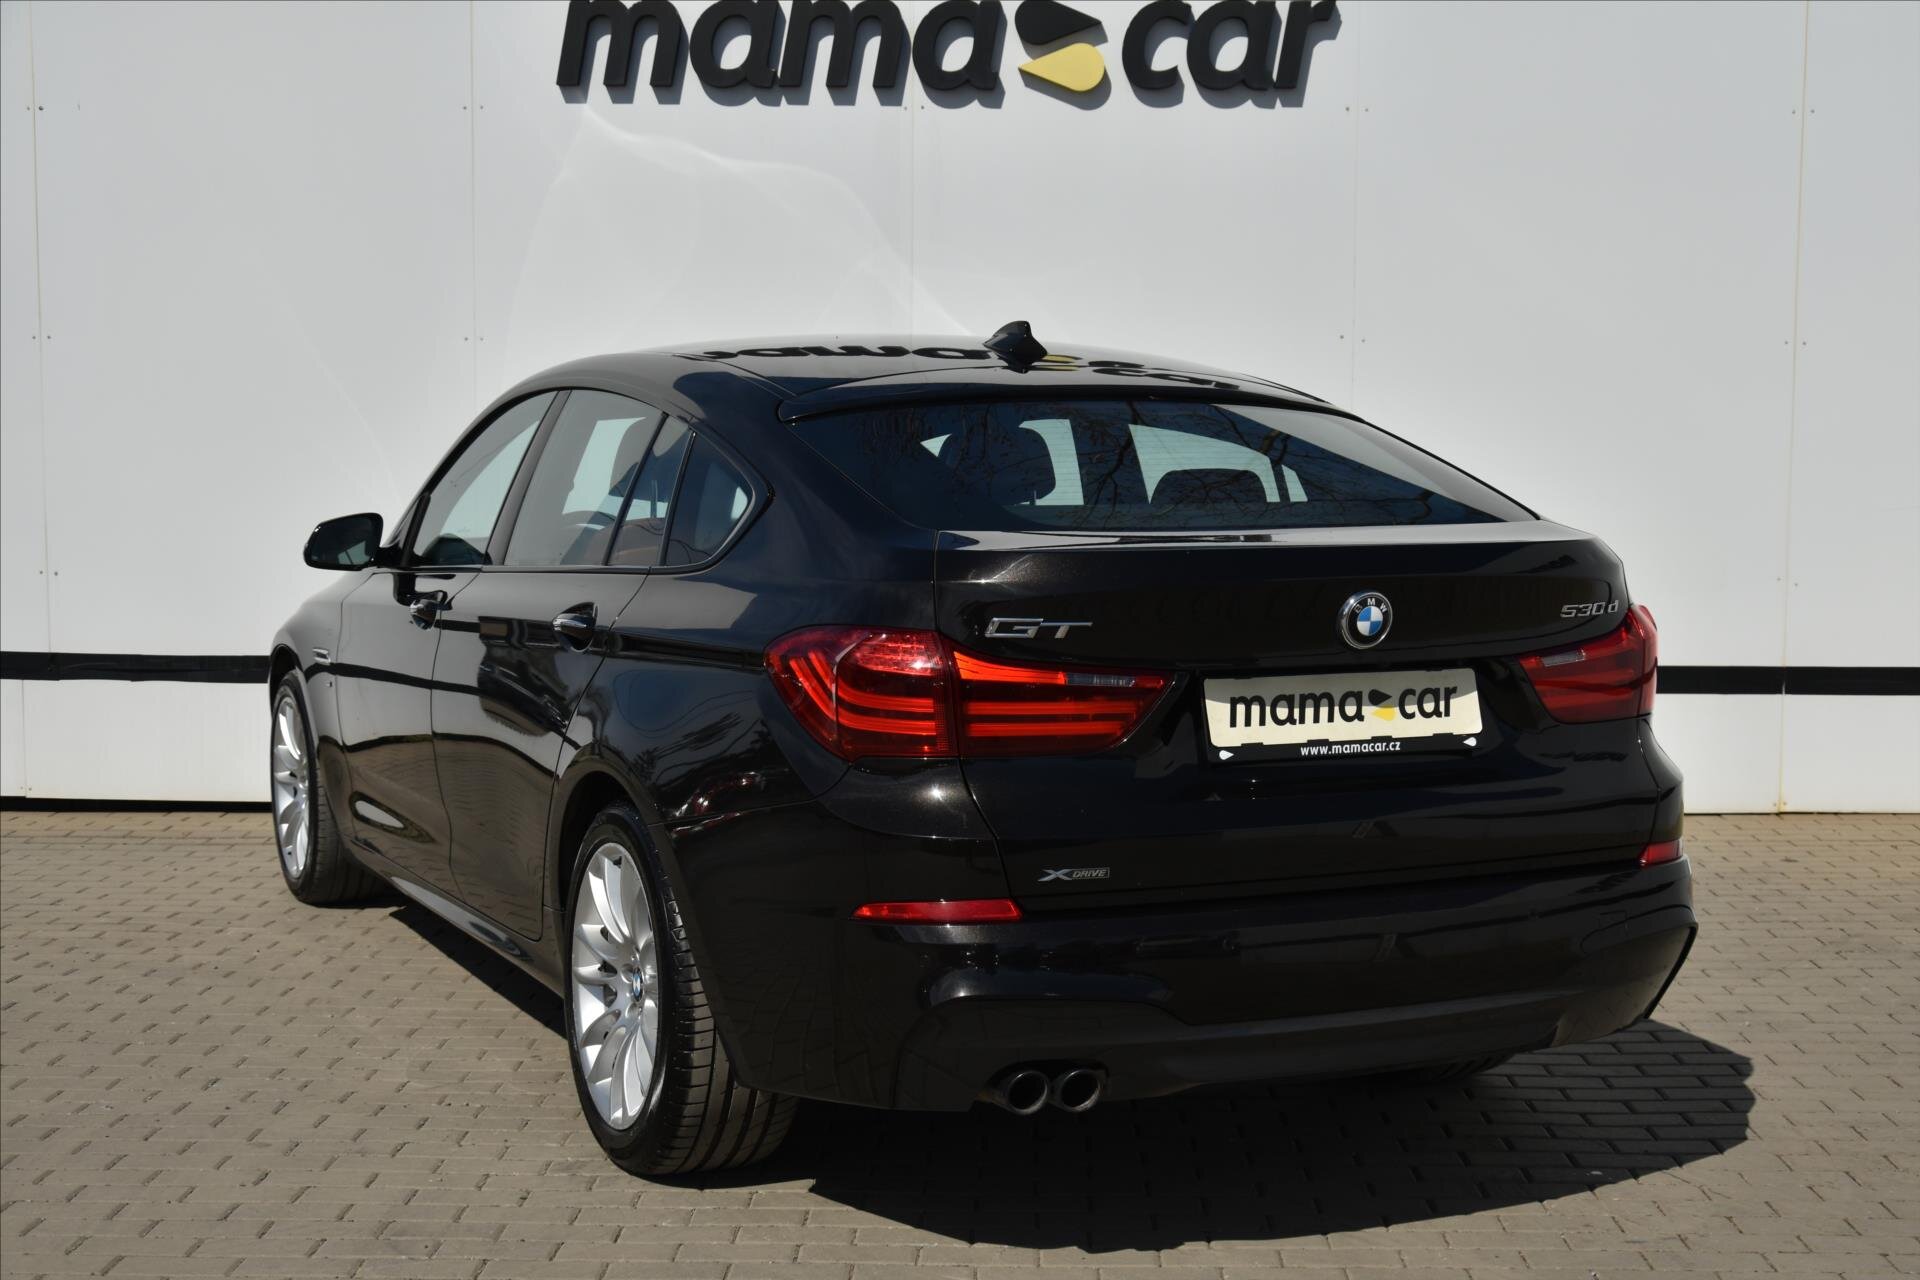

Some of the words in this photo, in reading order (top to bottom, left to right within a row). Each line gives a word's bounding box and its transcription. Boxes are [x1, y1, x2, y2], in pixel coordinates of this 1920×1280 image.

[556, 0, 1000, 90] mama
[1121, 0, 1337, 90] car
[1354, 597, 1388, 613] BMW
[985, 617, 1093, 639] GT
[1229, 690, 1365, 728] mama
[1398, 686, 1458, 720] car
[1300, 741, 1401, 756] www.mamacar.cz
